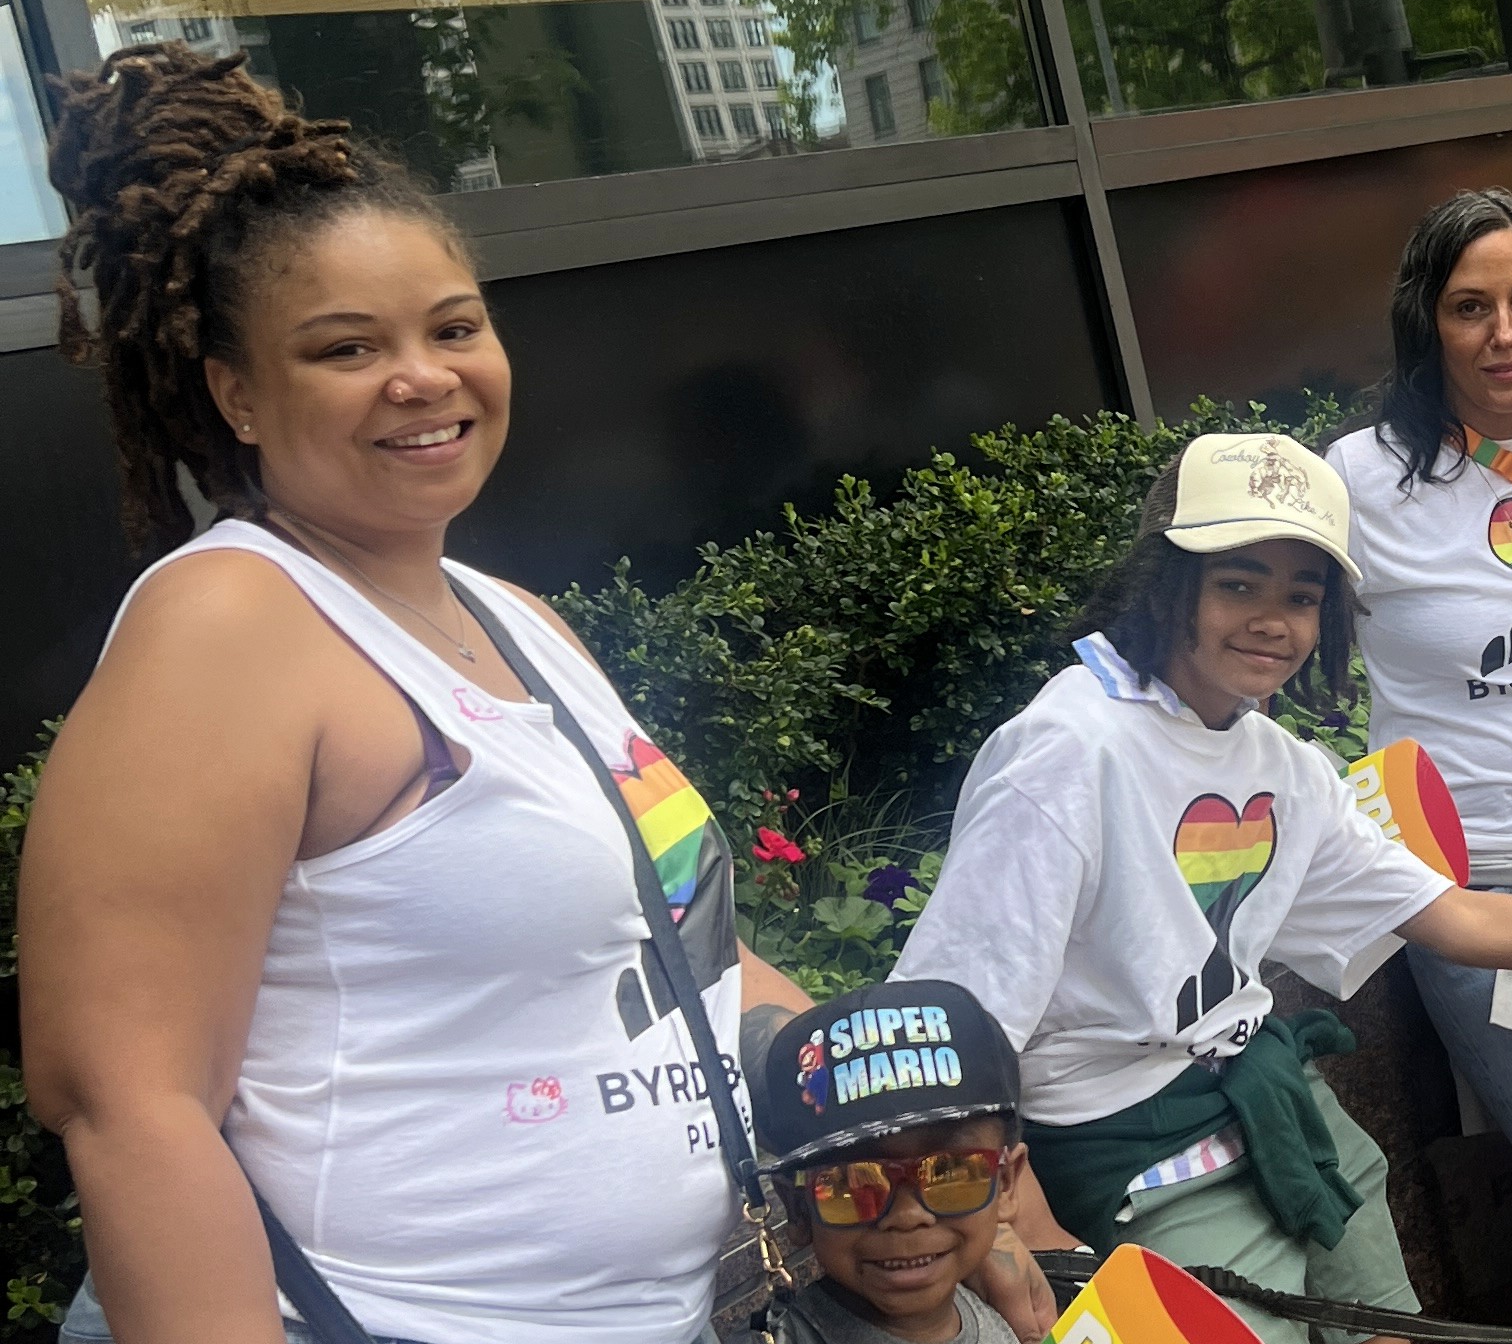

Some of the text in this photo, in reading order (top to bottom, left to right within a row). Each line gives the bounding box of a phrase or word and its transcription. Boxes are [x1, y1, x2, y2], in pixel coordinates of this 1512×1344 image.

[1210, 449, 1261, 469] Cowboy
[829, 1005, 952, 1060] SUPER
[596, 1061, 711, 1115] BYRD
[832, 1045, 963, 1106] MARIO
